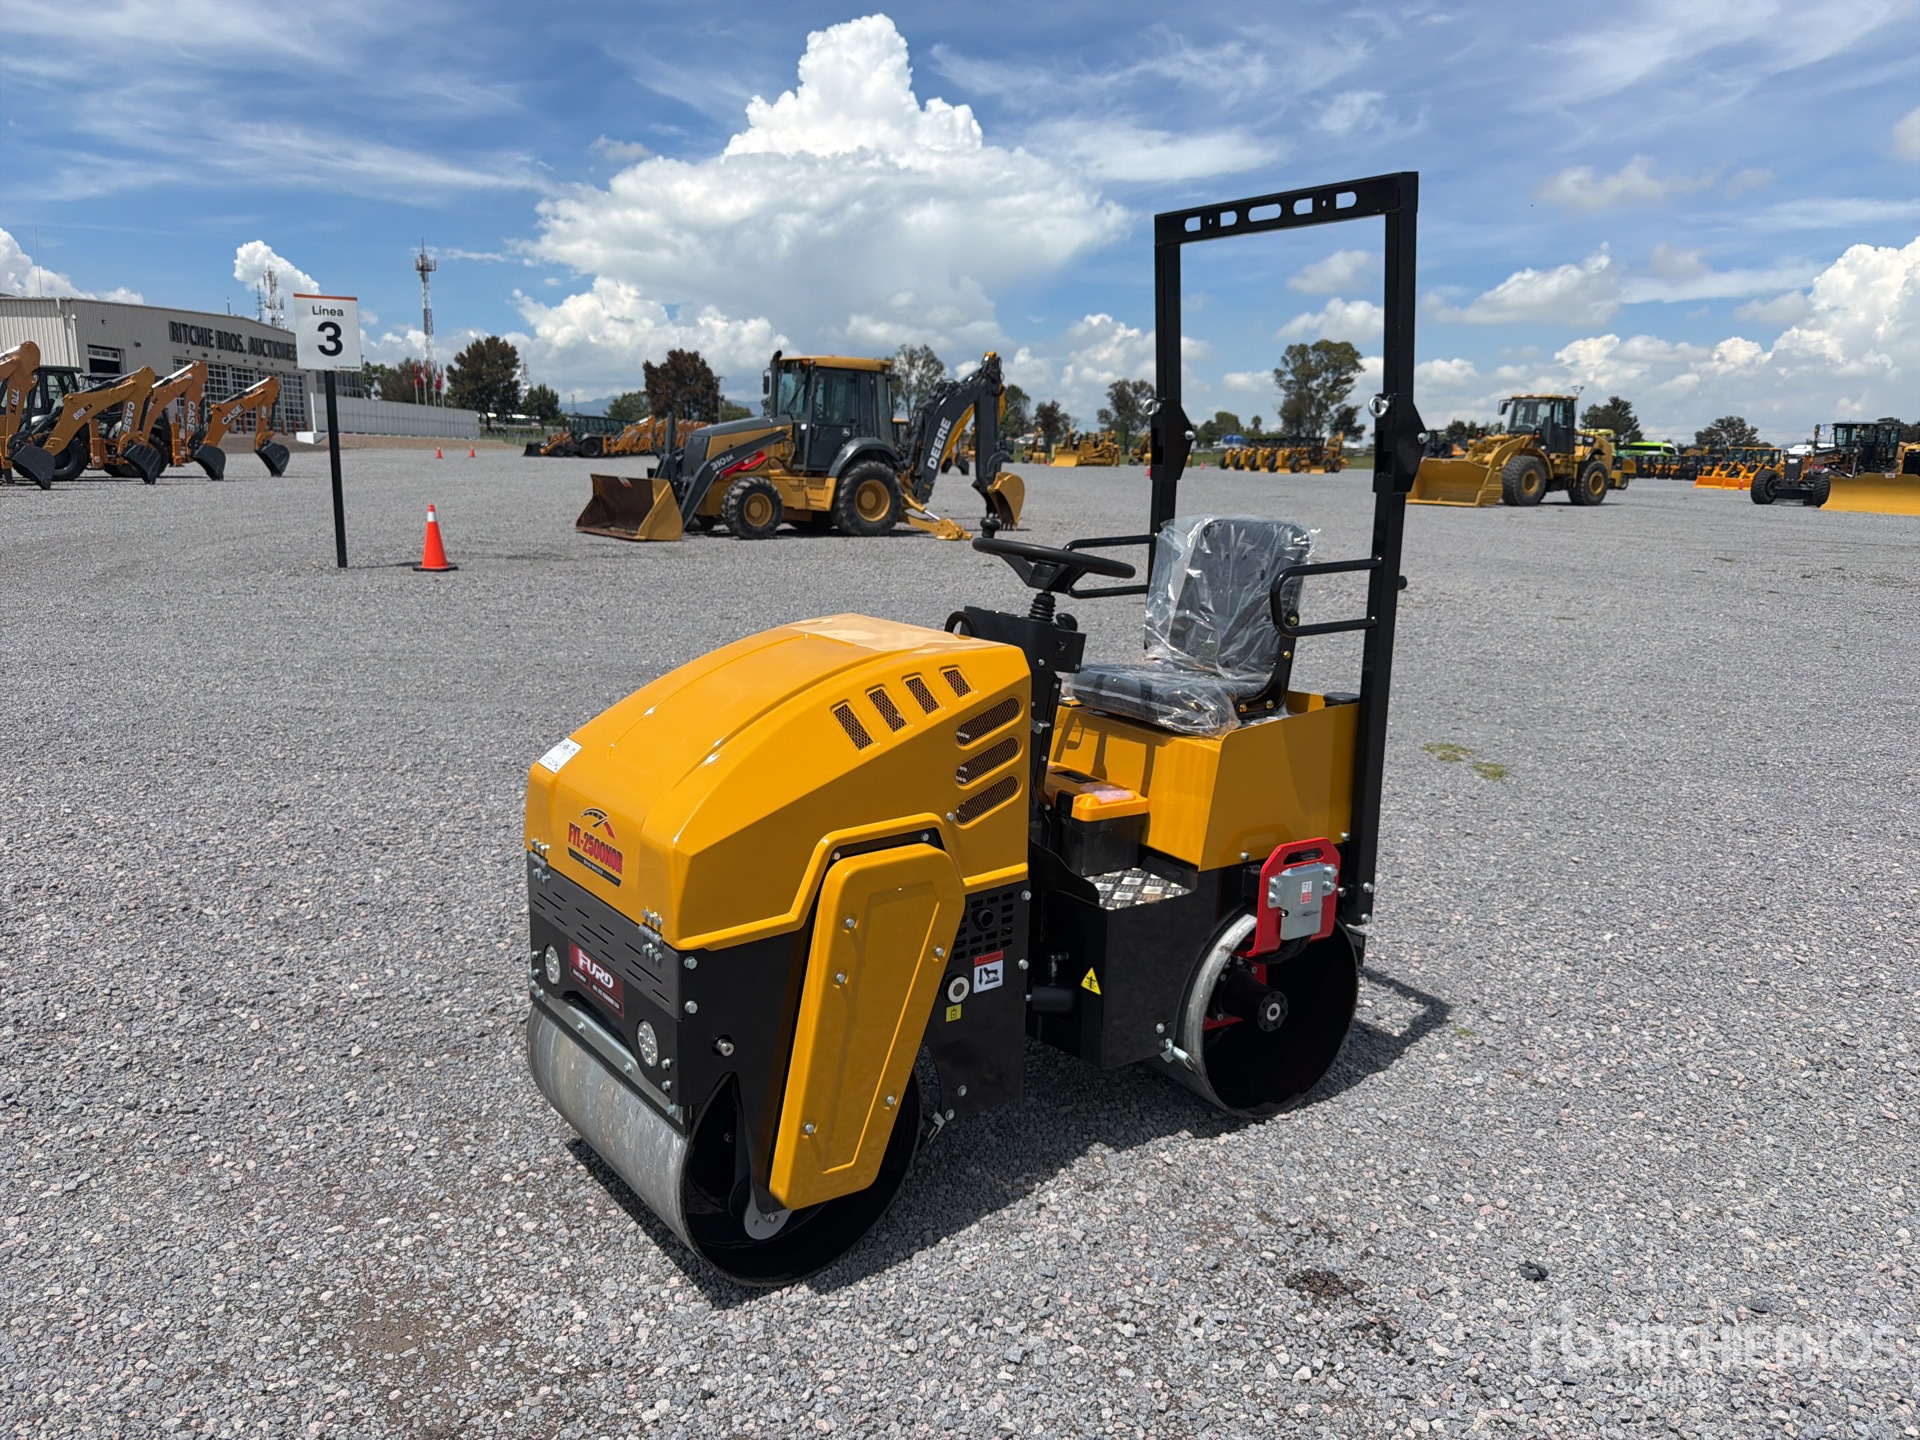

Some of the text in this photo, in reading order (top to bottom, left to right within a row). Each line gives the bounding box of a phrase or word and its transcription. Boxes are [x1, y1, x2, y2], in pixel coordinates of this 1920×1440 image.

[312, 305, 344, 317] Línea
[168, 321, 215, 349] RITCHIE
[317, 321, 344, 357] 3
[122, 401, 135, 433] CASE
[187, 401, 196, 432] CASE
[222, 404, 244, 425] CASE
[927, 416, 952, 470] DEERE
